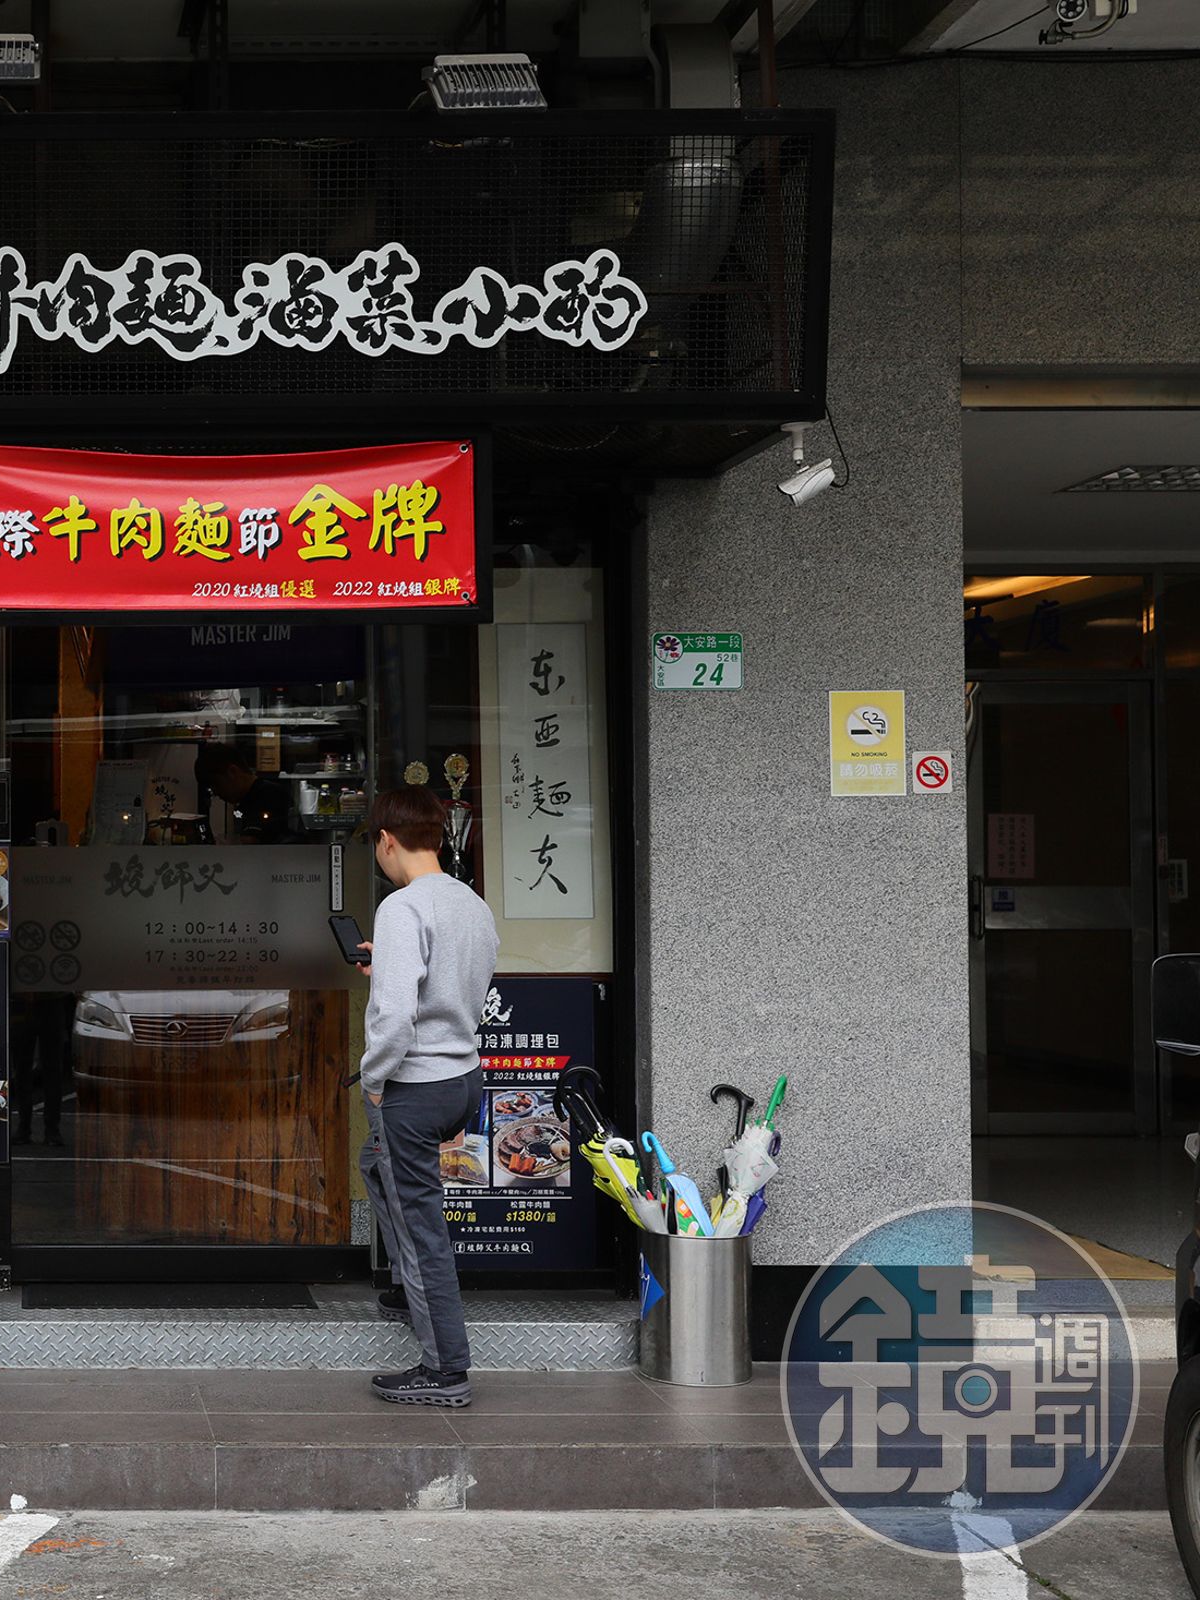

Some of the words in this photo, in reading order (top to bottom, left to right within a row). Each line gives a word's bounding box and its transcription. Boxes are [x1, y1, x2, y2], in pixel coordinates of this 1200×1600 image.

[191, 625, 257, 647] MASTER
[263, 624, 292, 642] JIM
[684, 636, 741, 649] 大安路一段
[716, 654, 738, 662] 52巷
[692, 663, 725, 686] 24
[271, 874, 304, 884] MASTER
[306, 873, 321, 884] JIM
[493, 1072, 515, 1080] 2022
